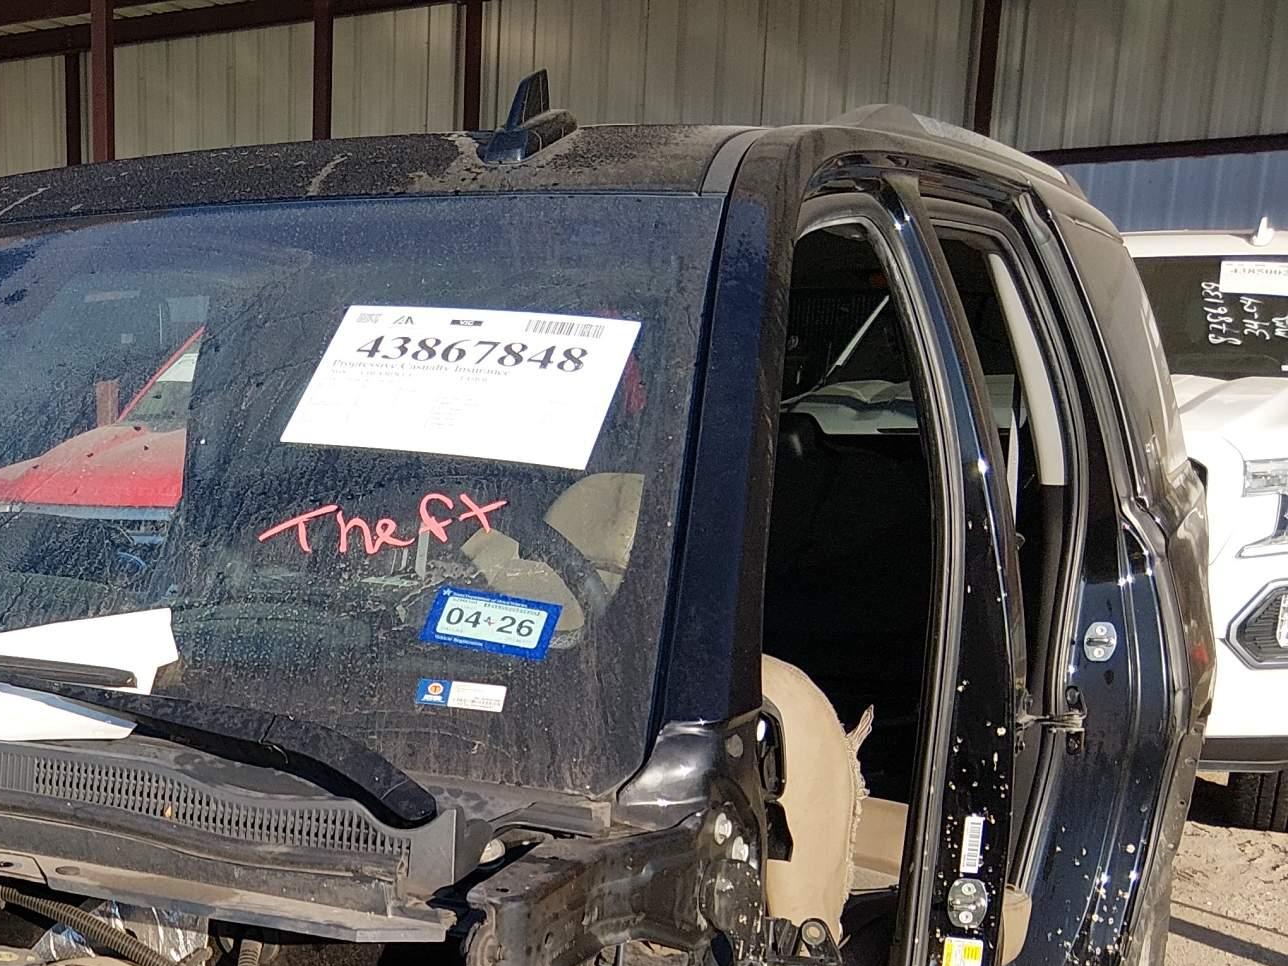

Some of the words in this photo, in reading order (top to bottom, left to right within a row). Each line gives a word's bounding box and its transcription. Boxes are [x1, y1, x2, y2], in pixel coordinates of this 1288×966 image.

[356, 335, 588, 373] 43867848
[445, 607, 482, 629] 04
[495, 615, 536, 637] 26
